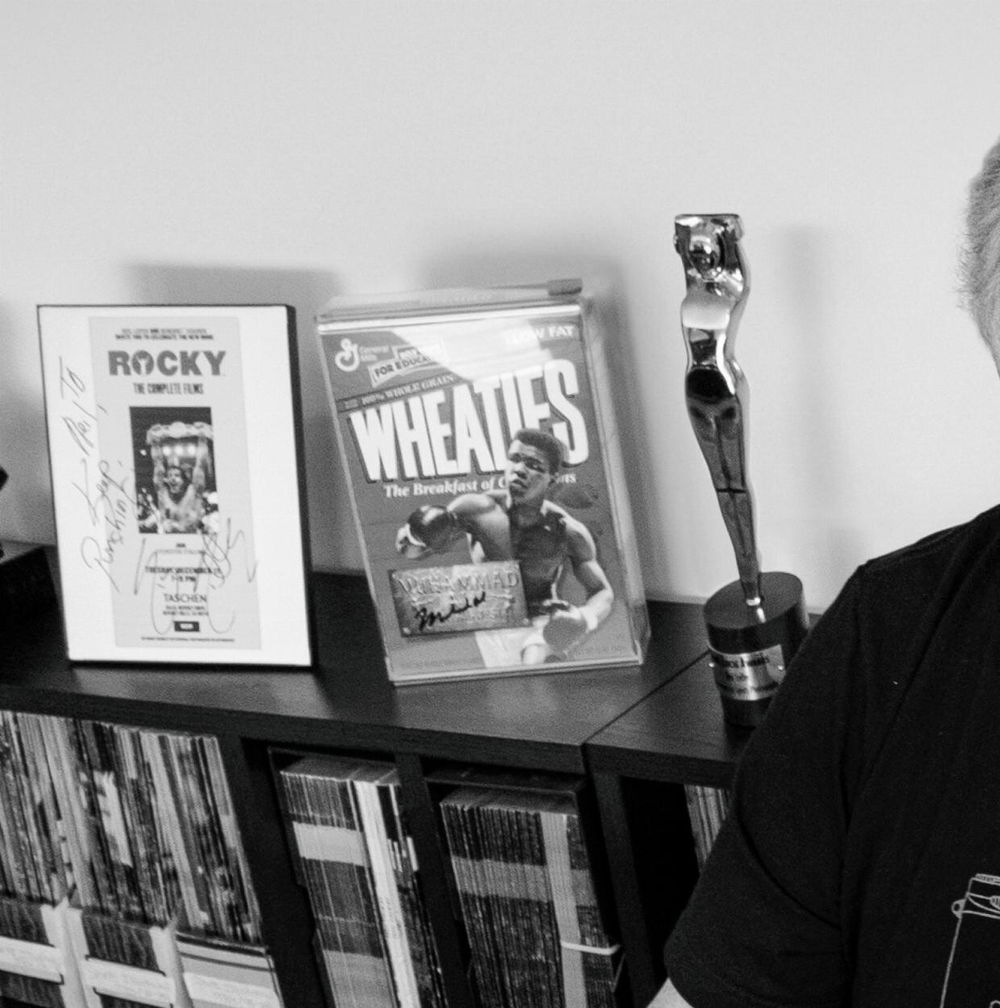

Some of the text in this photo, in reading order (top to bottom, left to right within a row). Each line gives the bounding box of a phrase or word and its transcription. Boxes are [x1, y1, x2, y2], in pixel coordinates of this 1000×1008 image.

[548, 325, 575, 338] FAT
[108, 350, 226, 377] ROCKY
[374, 364, 394, 377] FOR
[133, 382, 204, 394] THE COMPLETE FILMS
[385, 382, 420, 399] WHOLE
[421, 374, 456, 390] GRAIN
[348, 359, 589, 482] WHEATIES
[386, 484, 410, 498] The
[413, 478, 478, 496] Breakfast
[480, 475, 495, 490] of
[163, 593, 208, 603] TASCHEN
